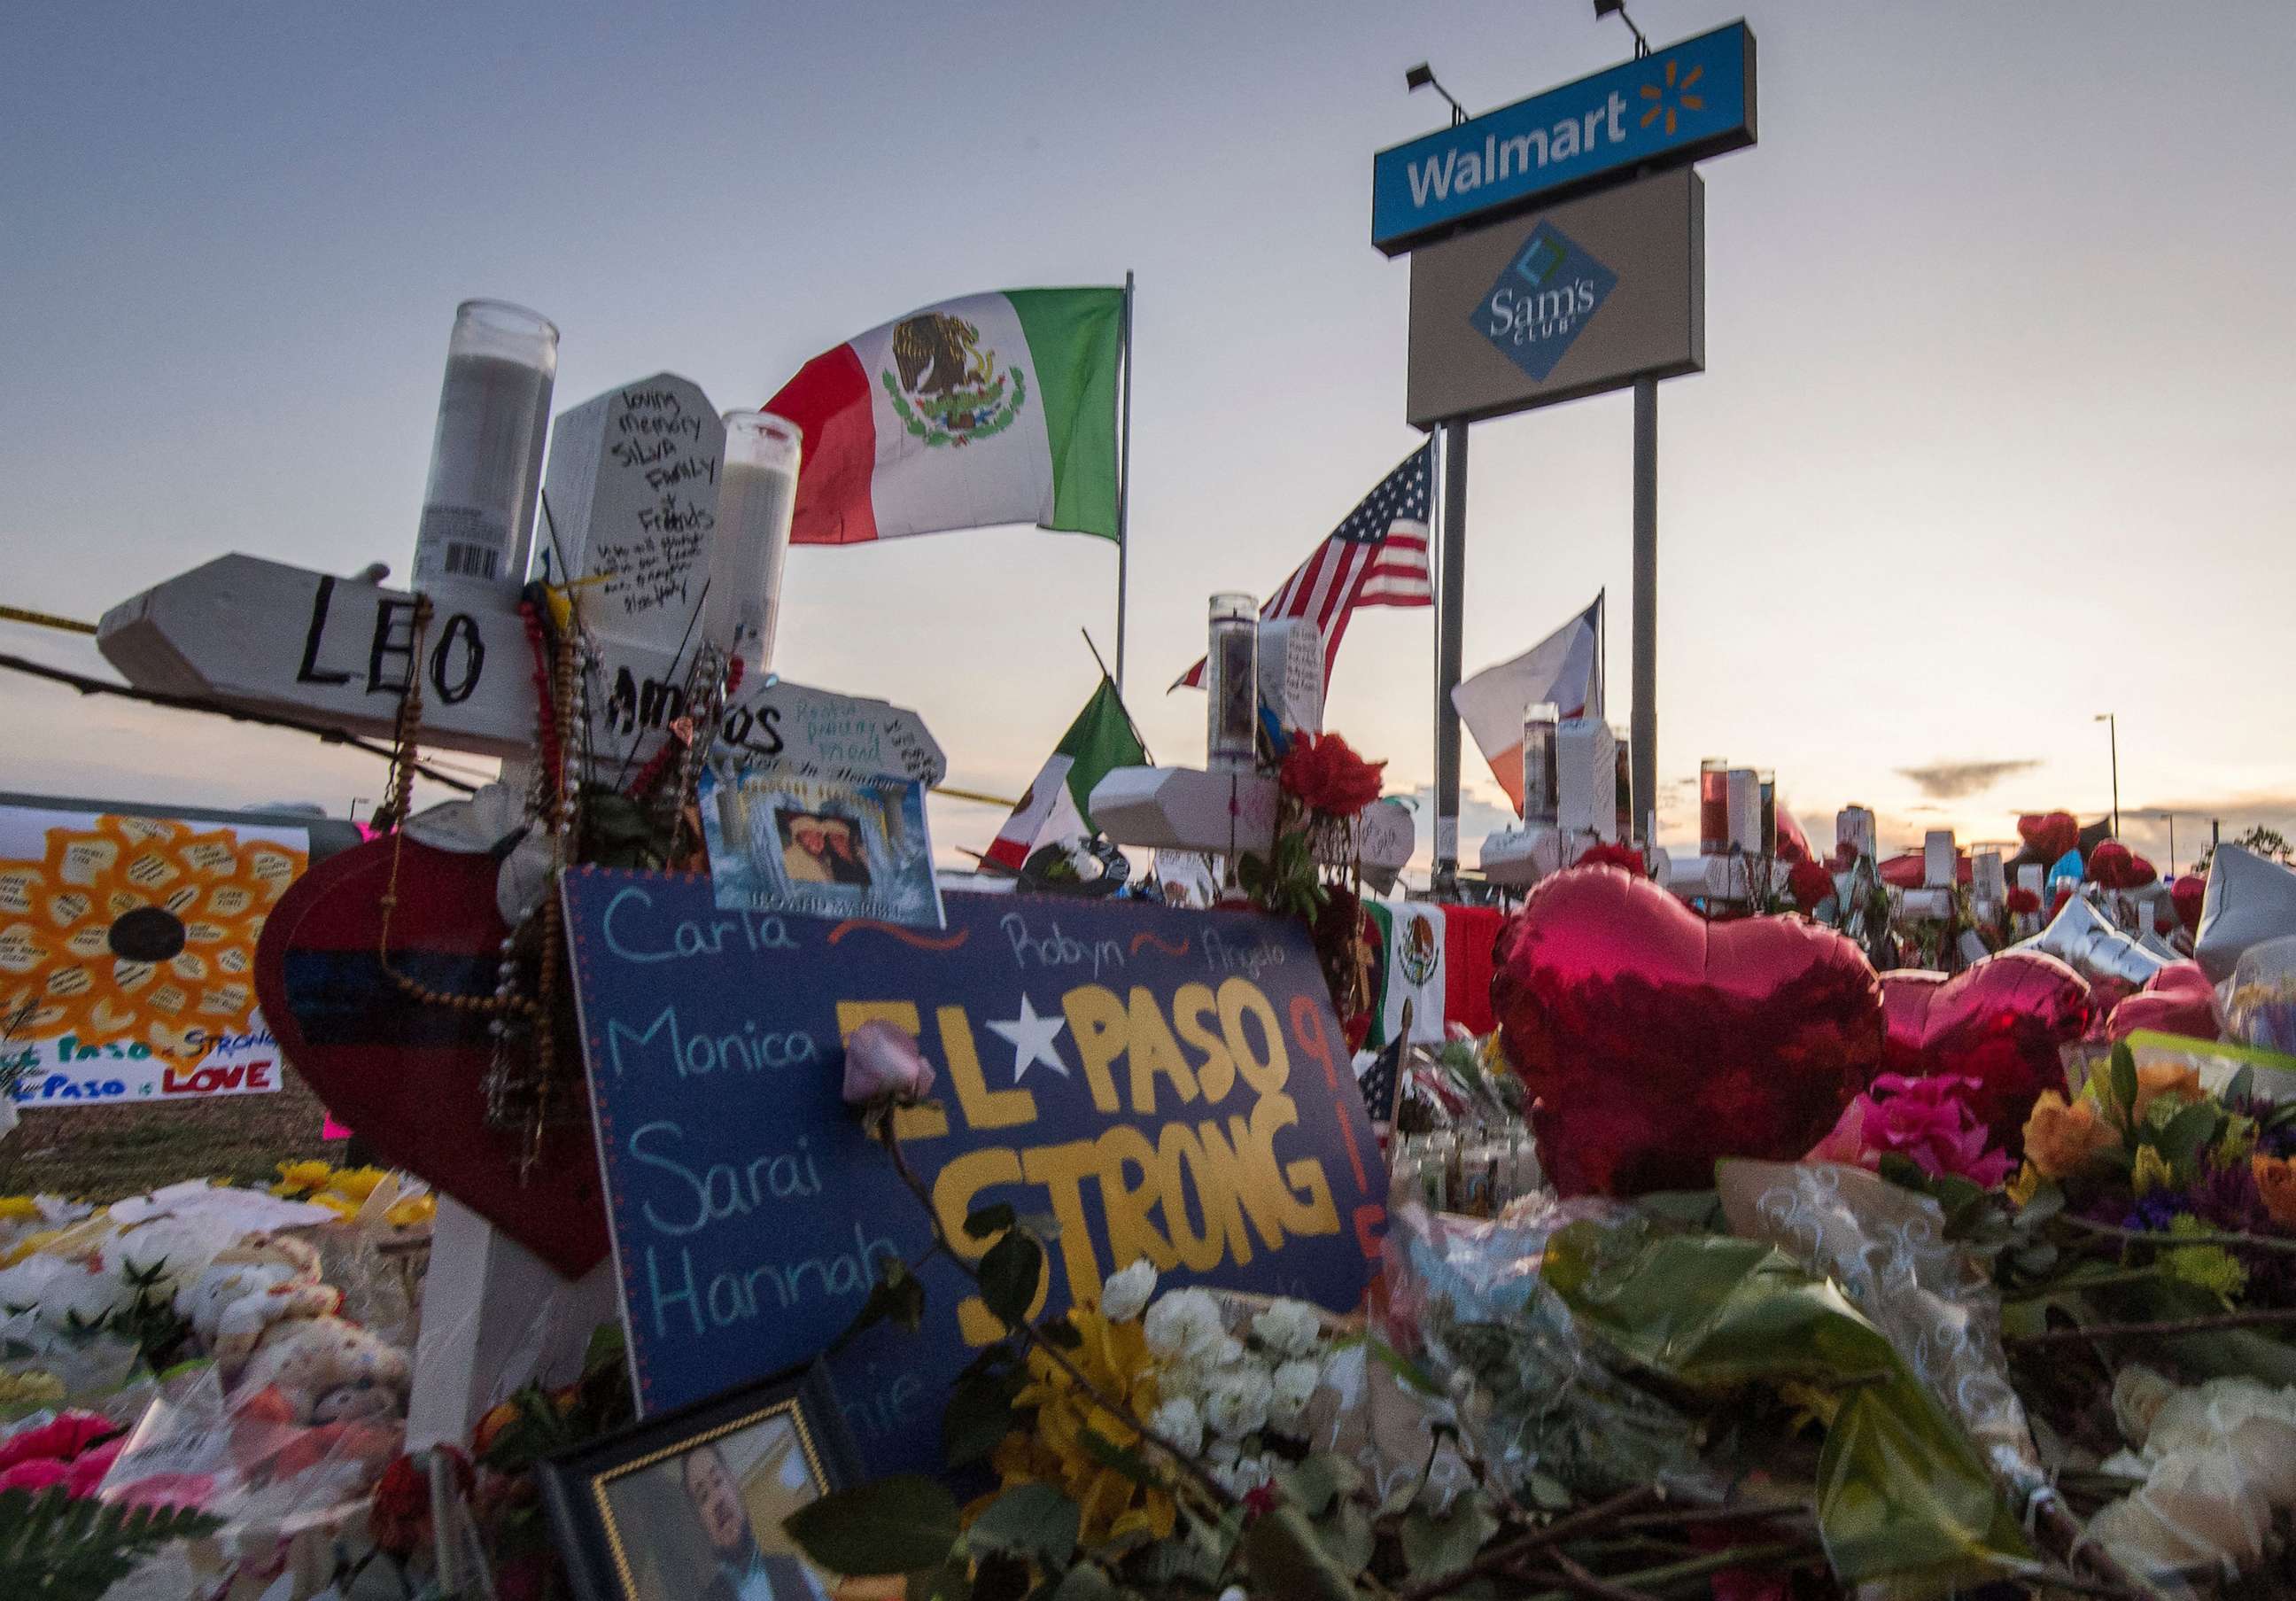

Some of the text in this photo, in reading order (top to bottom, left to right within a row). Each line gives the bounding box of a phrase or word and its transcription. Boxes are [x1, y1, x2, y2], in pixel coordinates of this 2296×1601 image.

[1407, 90, 1626, 207] Walmart
[1489, 276, 1594, 338] Sam's
[1513, 319, 1569, 346] CLUB
[297, 574, 485, 704] LEO
[602, 887, 798, 962] Carla
[1000, 912, 1127, 980] Robyn
[162, 1061, 273, 1094] LOVE
[607, 1006, 818, 1080] Monica
[1061, 977, 1290, 1115] PASO
[629, 1119, 824, 1237] Sarai
[932, 1092, 1342, 1347] STRONG
[646, 1221, 900, 1338] Hannah
